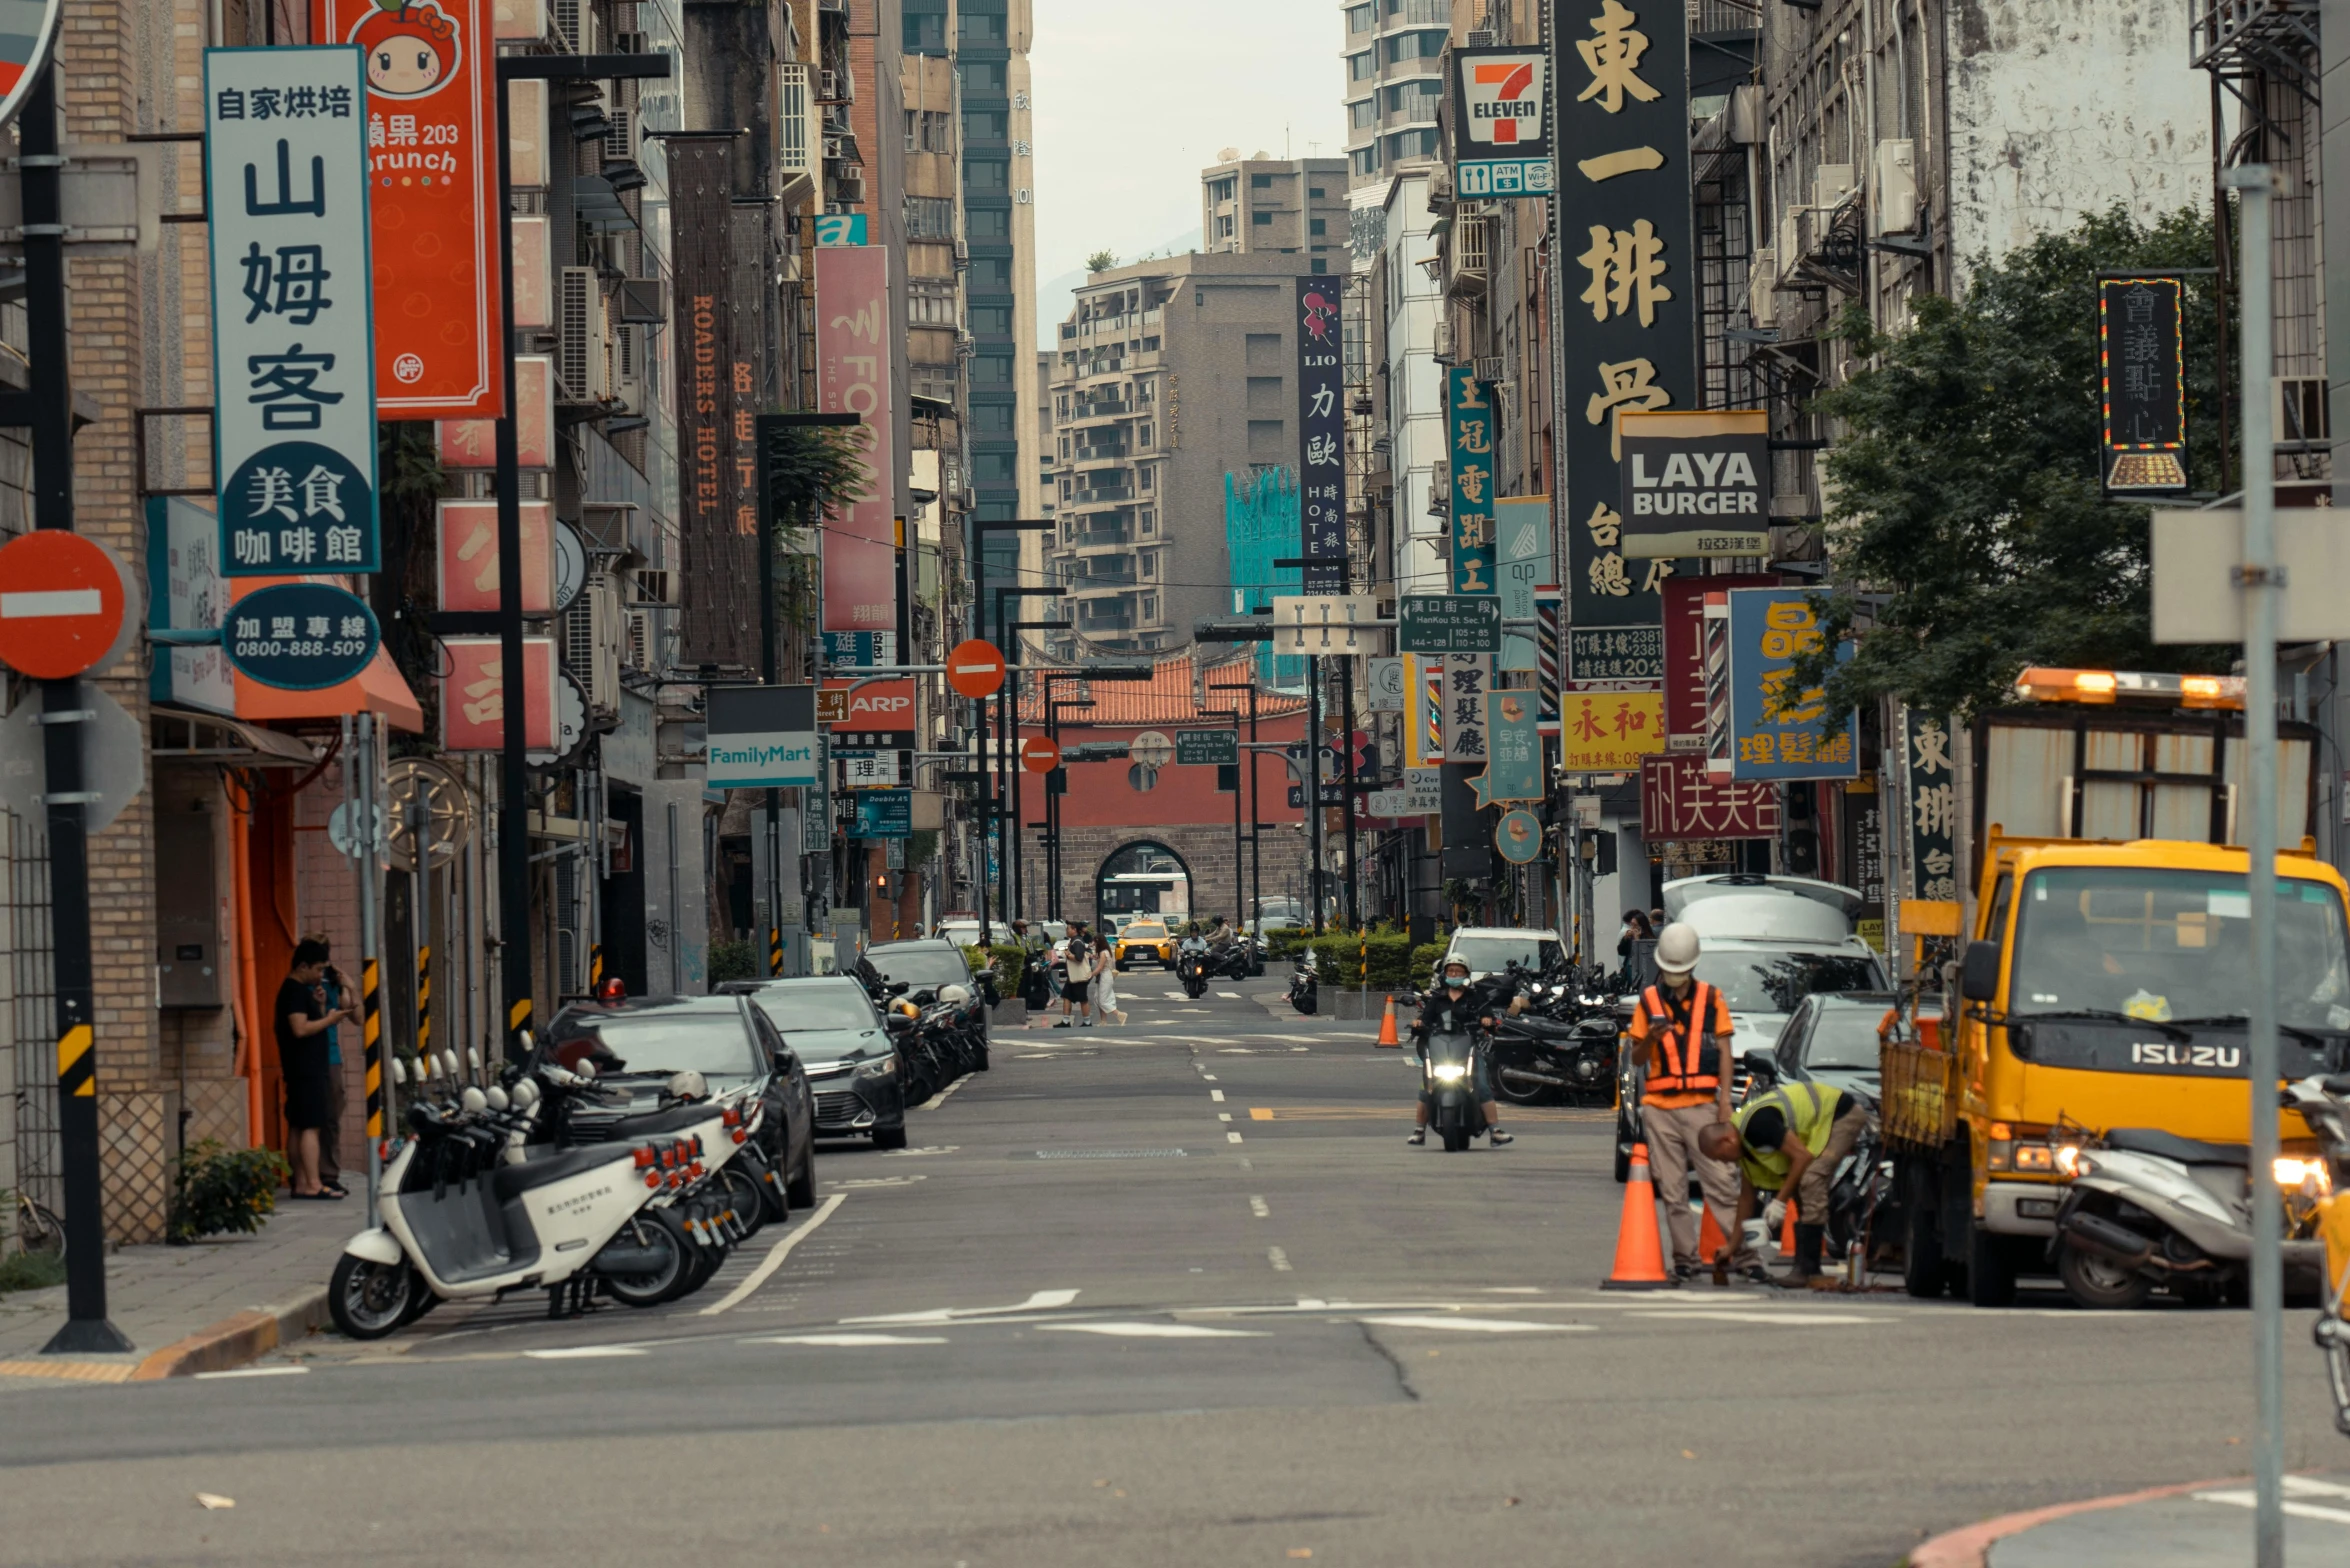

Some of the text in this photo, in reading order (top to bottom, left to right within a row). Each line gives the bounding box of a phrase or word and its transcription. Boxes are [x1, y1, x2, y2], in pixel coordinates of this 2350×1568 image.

[1475, 62, 1532, 142] 7
[422, 125, 459, 144] 203
[1496, 167, 1519, 175] ATM
[240, 138, 344, 431] 山姆客
[1305, 356, 1337, 367] LIO
[2122, 283, 2161, 442] 會議點心
[694, 294, 718, 516] ROADERS HOTEL
[1307, 383, 1340, 467] 力歐
[1632, 452, 1758, 487] LAYA
[247, 464, 346, 522] 美食
[1633, 491, 1759, 515] BURGER
[235, 525, 362, 564] 咖啡館
[1698, 537, 1761, 550] 拉亞漢堡
[1411, 600, 1491, 613] 漢口街一段
[236, 616, 366, 638] 加盟專線
[1416, 616, 1448, 624] HanKou
[1450, 616, 1462, 624] St.
[1463, 616, 1480, 624] Sec.
[236, 641, 366, 656] 0800-888-509
[710, 746, 811, 768] FamilyMart
[1739, 732, 1851, 765] 理髮廳
[2132, 1043, 2240, 1068] ISUZU
